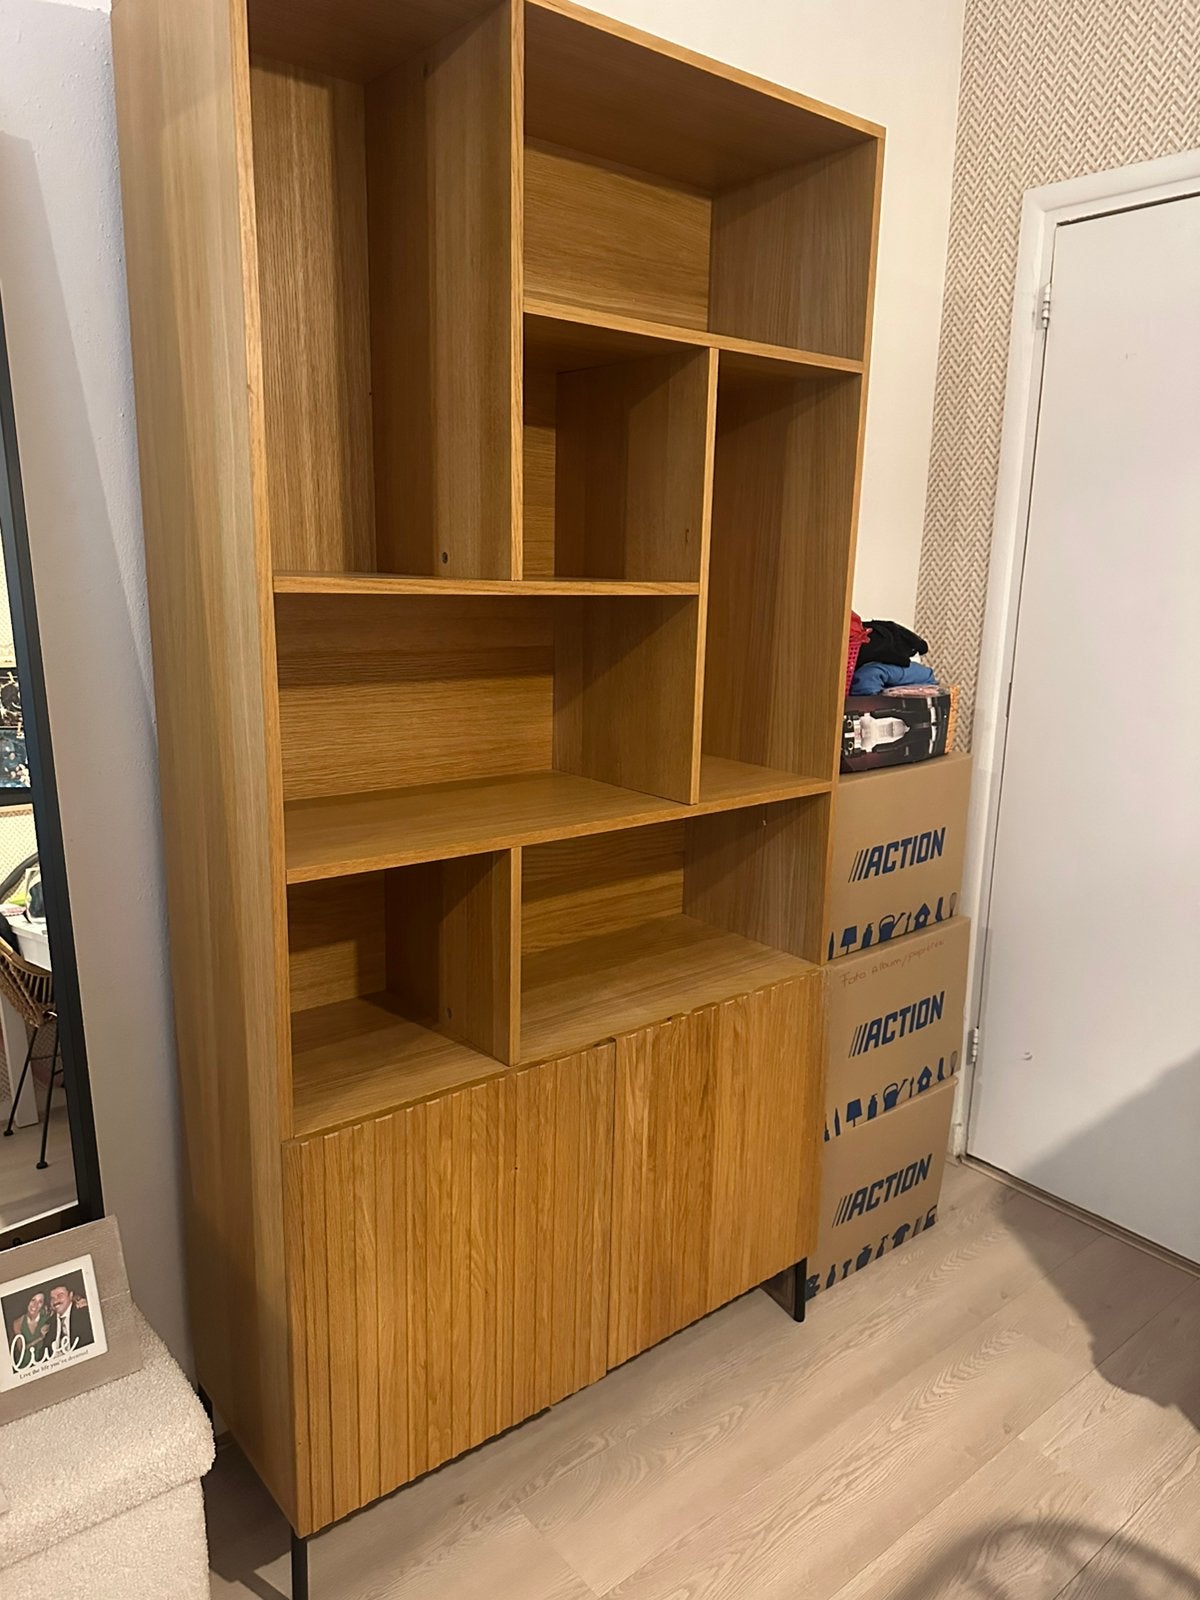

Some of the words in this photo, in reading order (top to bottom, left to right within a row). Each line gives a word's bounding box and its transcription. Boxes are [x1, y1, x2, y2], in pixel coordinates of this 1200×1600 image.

[863, 827, 946, 880] ACTION
[862, 990, 945, 1053] ACTION
[847, 1153, 933, 1221] ACTION
[11, 1334, 80, 1372] live
